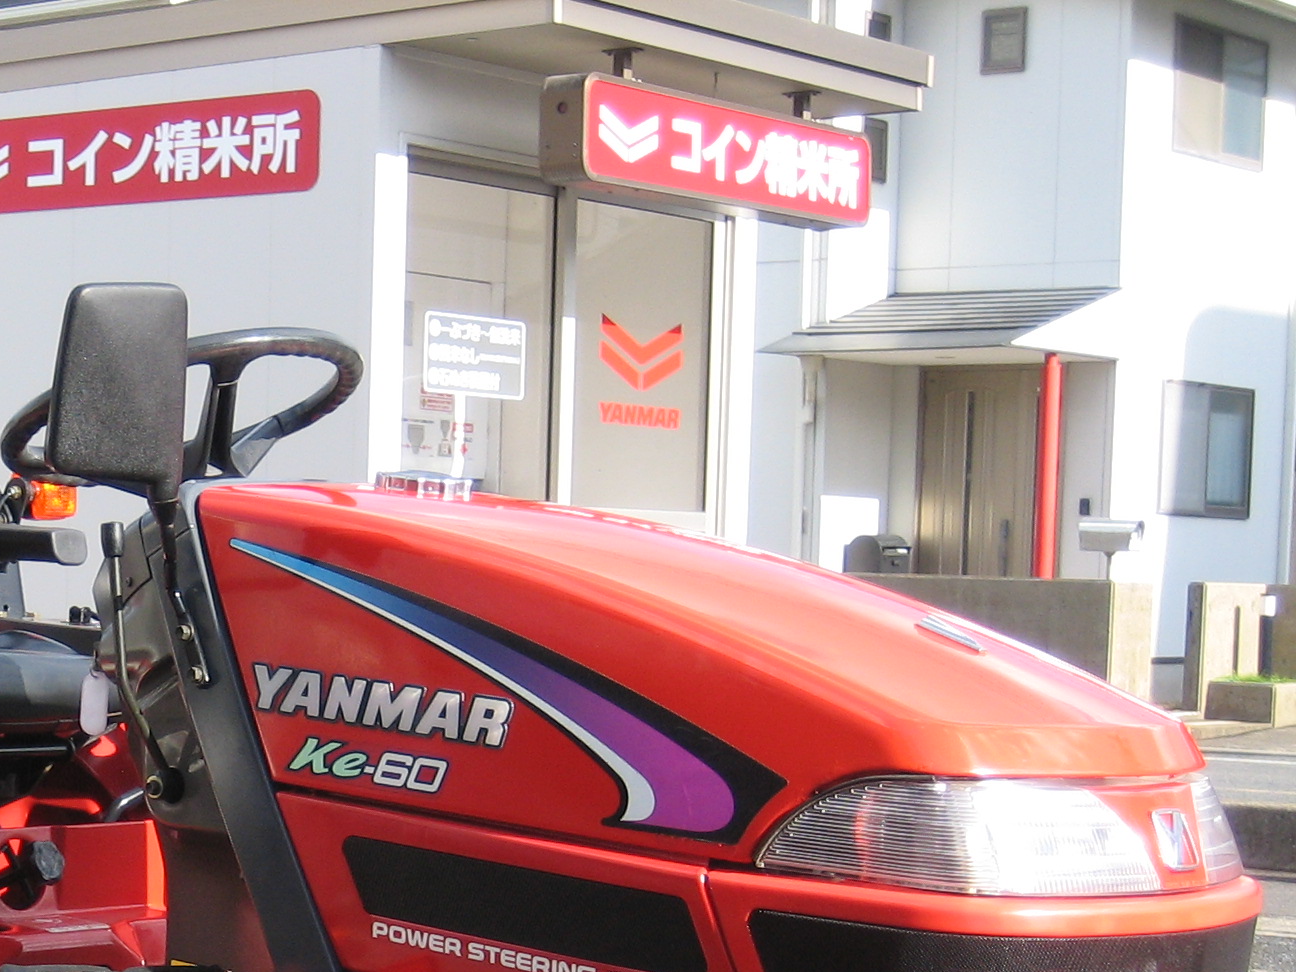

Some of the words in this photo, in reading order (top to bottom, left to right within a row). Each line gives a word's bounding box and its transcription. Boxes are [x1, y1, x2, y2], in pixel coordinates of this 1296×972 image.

[25, 109, 302, 188] コイン精米所
[670, 117, 860, 210] コイン精米所
[598, 402, 682, 430] YANMAR
[252, 663, 515, 749] YANMAR
[286, 737, 448, 793] Ke-60
[371, 921, 462, 957] POWER
